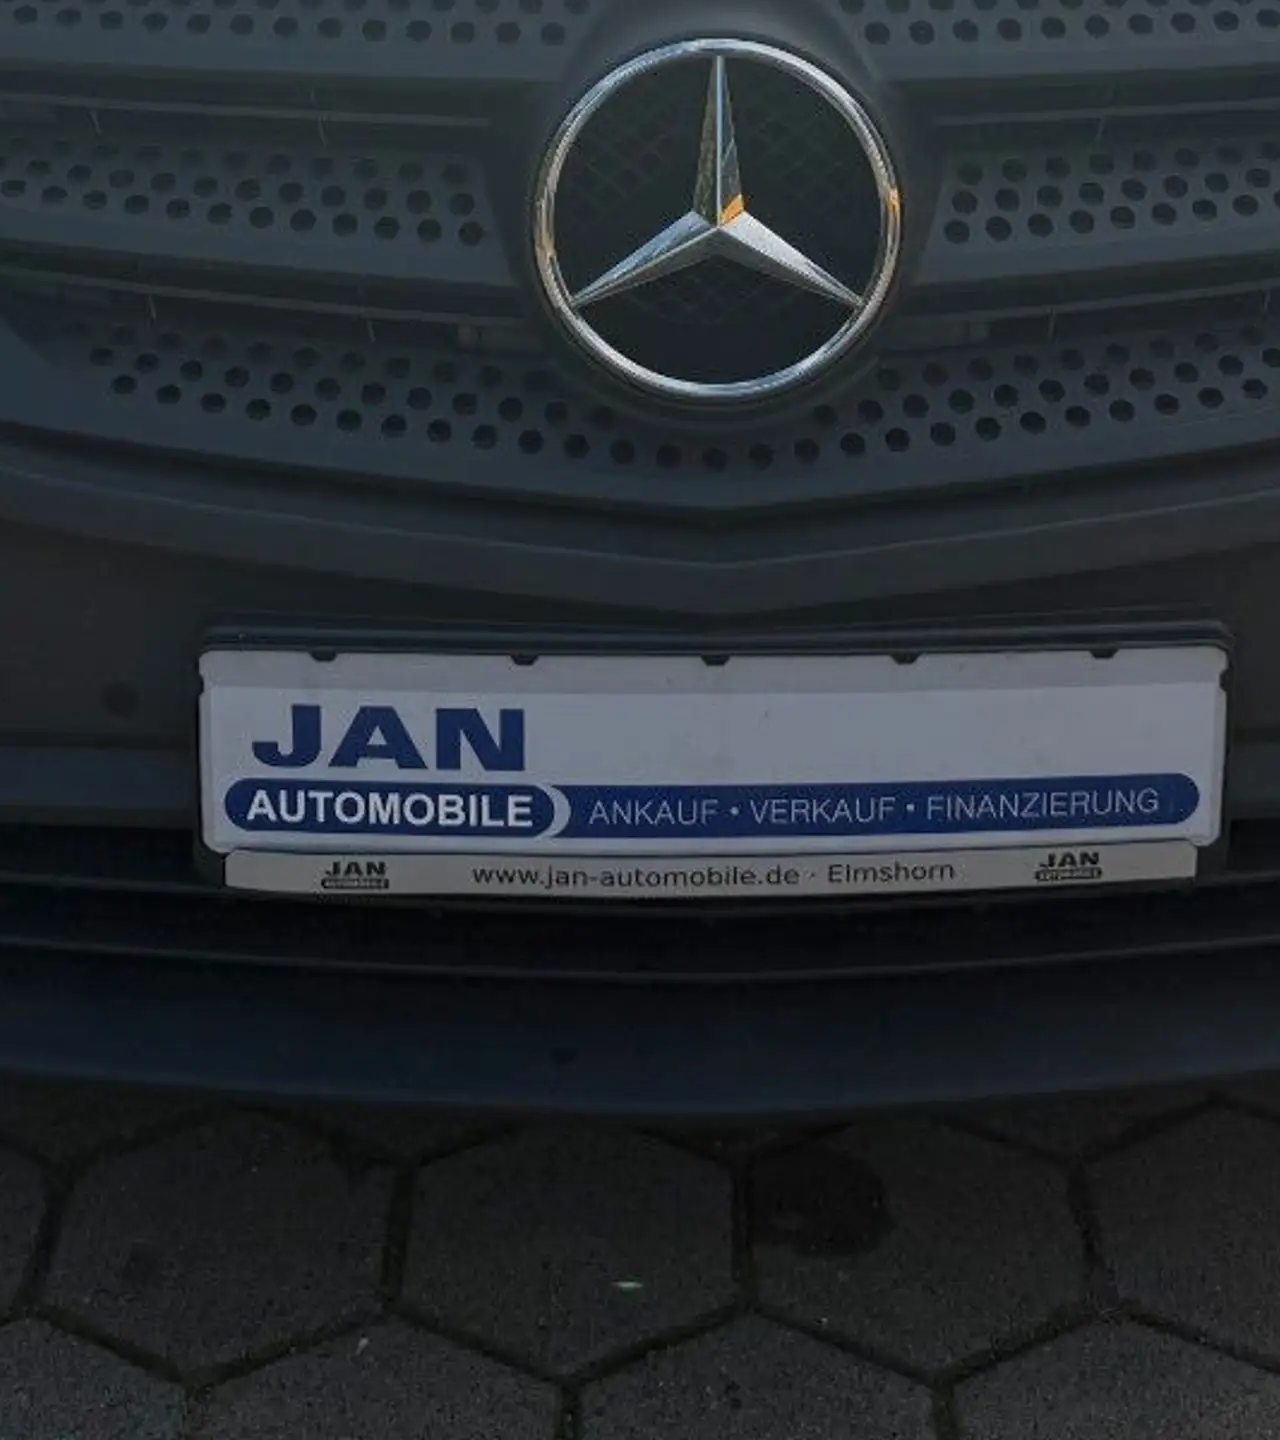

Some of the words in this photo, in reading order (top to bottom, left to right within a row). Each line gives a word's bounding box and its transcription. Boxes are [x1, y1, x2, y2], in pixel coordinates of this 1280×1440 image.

[252, 704, 526, 771] JAN
[246, 789, 534, 828] AUTOMOBILE
[588, 799, 719, 826] ANKAUF
[749, 796, 896, 824] VERKAUF
[926, 788, 1160, 820] FINANZIERUNG
[324, 861, 387, 876] JAN
[1039, 851, 1100, 868] JAN
[472, 865, 800, 889] www.jan-automobile.de
[827, 861, 956, 884] Elmshorn
